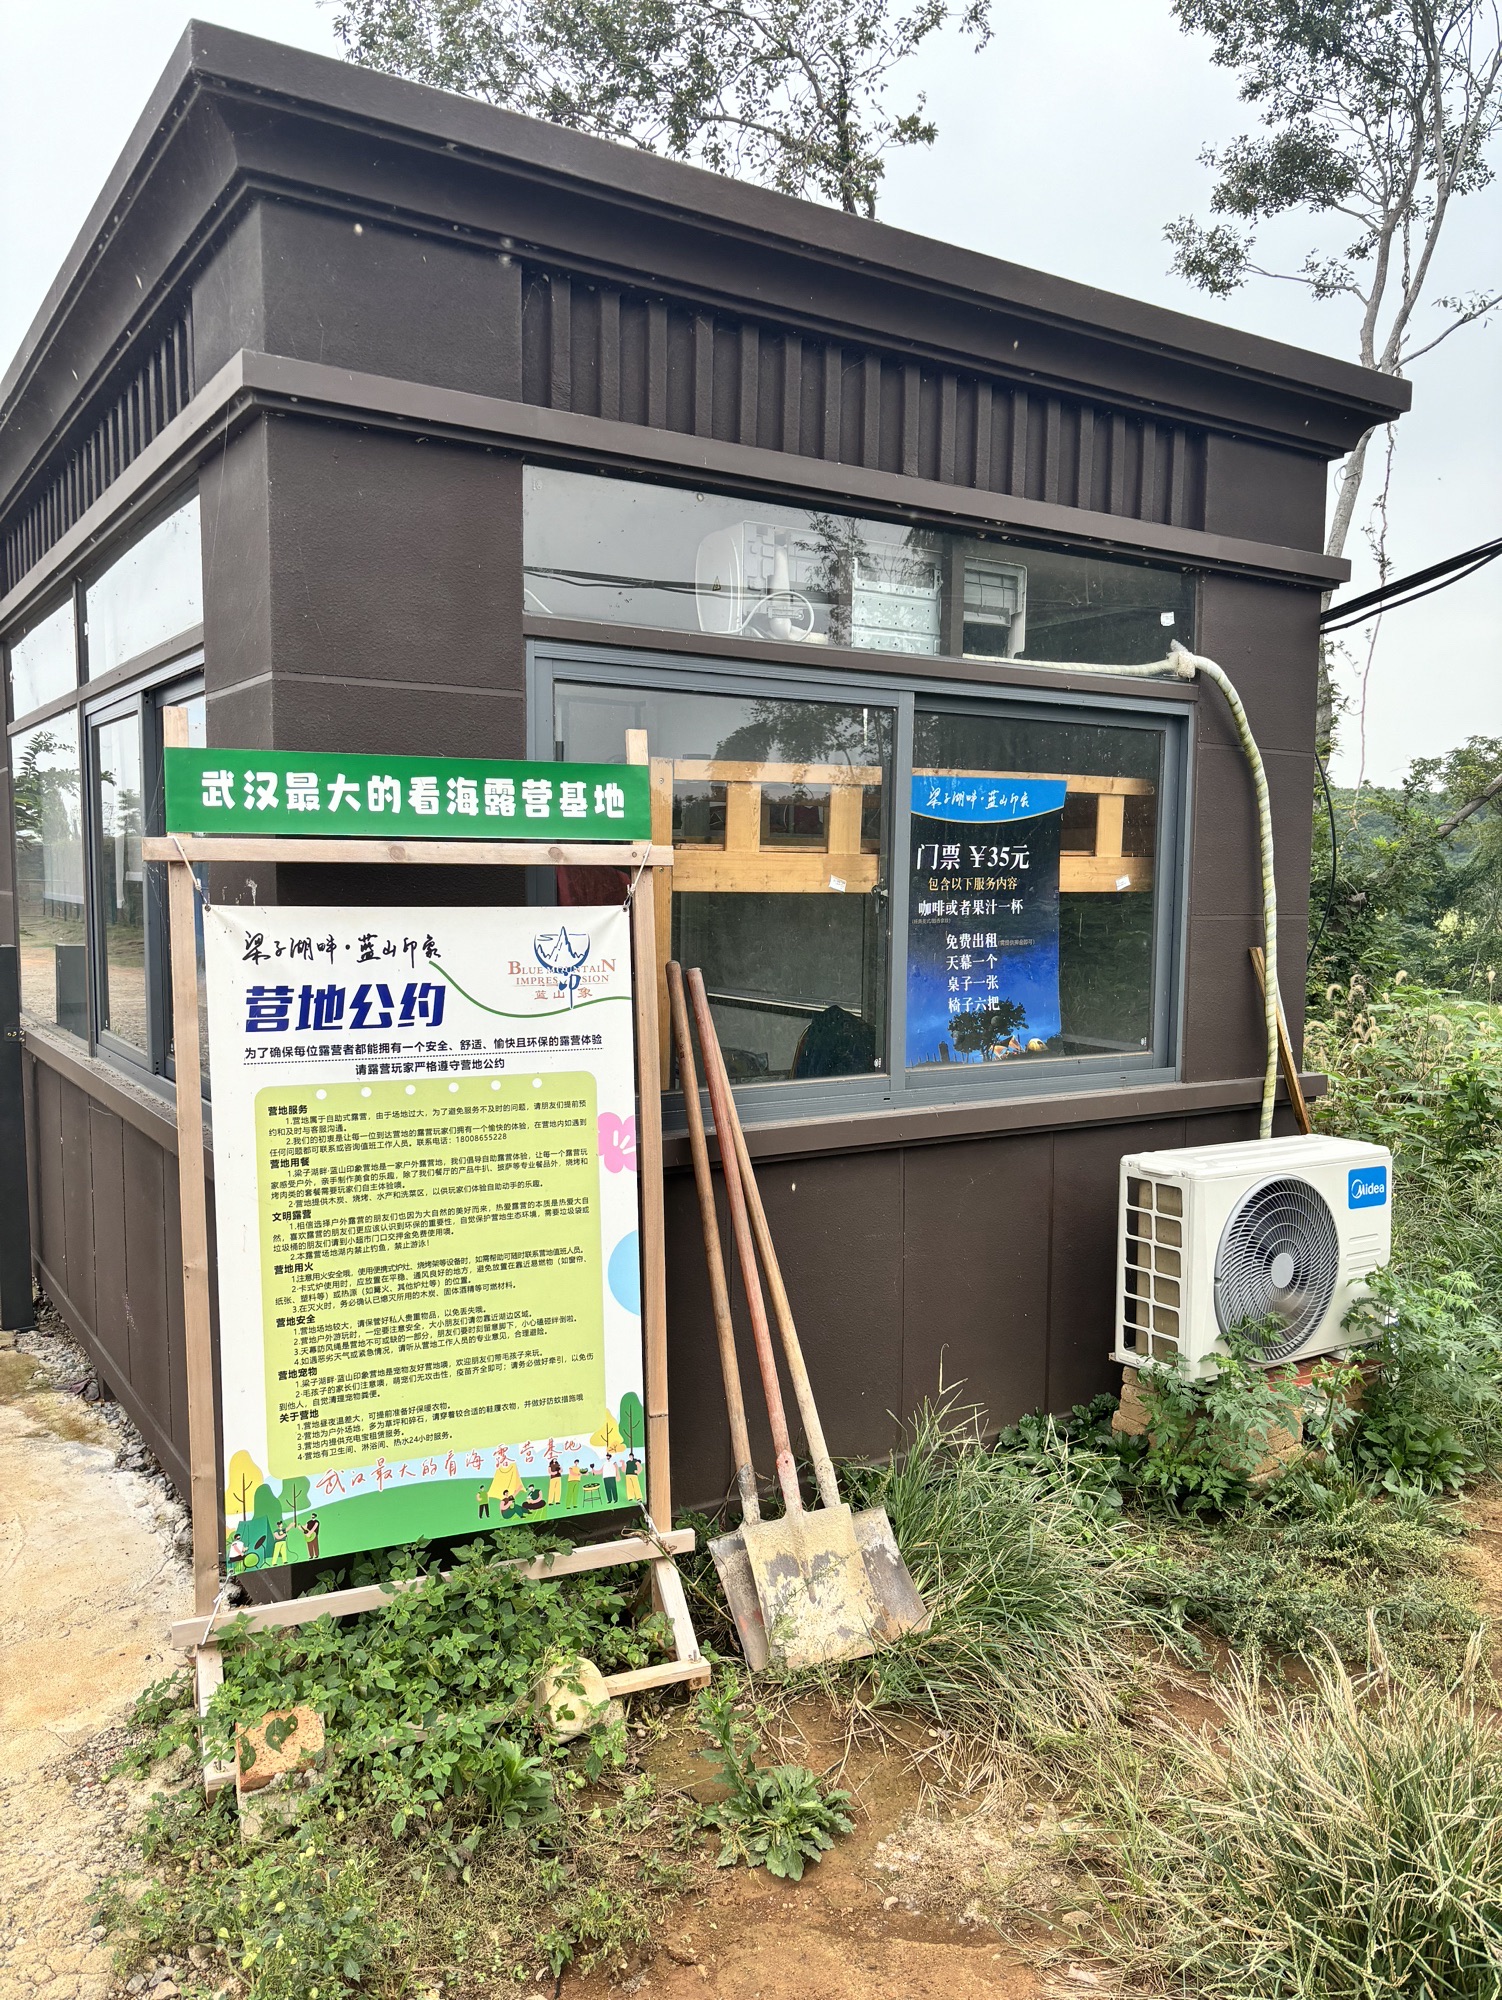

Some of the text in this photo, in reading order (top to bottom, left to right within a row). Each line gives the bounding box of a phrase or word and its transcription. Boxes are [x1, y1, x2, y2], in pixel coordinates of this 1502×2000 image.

[200, 769, 626, 819] 武汉最大的看海露营基地
[917, 844, 1029, 870] 门票 ¥35元
[928, 877, 1018, 892] 包含以下服务内容
[918, 899, 1023, 917] 咖啡或者果汁一杯
[946, 932, 998, 950] 免费出租
[508, 960, 543, 975] BLUE
[946, 954, 998, 971] 天幕一个
[947, 975, 999, 992] 桌子一张
[245, 982, 446, 1033] 营地公约
[948, 996, 1000, 1014] 椅子六把
[245, 1033, 603, 1060] 为了确保每位露营者都能拥有一个安全、舒适、愉快且环保的露营体验
[355, 1057, 505, 1076] 请露营玩家严格遵守营地公约
[268, 1104, 308, 1116] 营地服务
[268, 1124, 347, 1137] 约和及时与客服沟通。
[270, 1157, 310, 1169] 营地用餐
[1351, 1179, 1385, 1199] Midea
[272, 1209, 312, 1222] 文明露营
[274, 1262, 314, 1275] 营地用火
[276, 1314, 316, 1328] 营地安全
[278, 1367, 318, 1381] 营地宠物
[279, 1389, 381, 1412] 到他人，自觉清理宠物粪便。
[279, 1409, 319, 1423] 关于营地
[297, 1428, 405, 1451] 3.营地内提供充电宝租赁服务。
[316, 1437, 582, 1496] 武汉最大的看海露营基地
